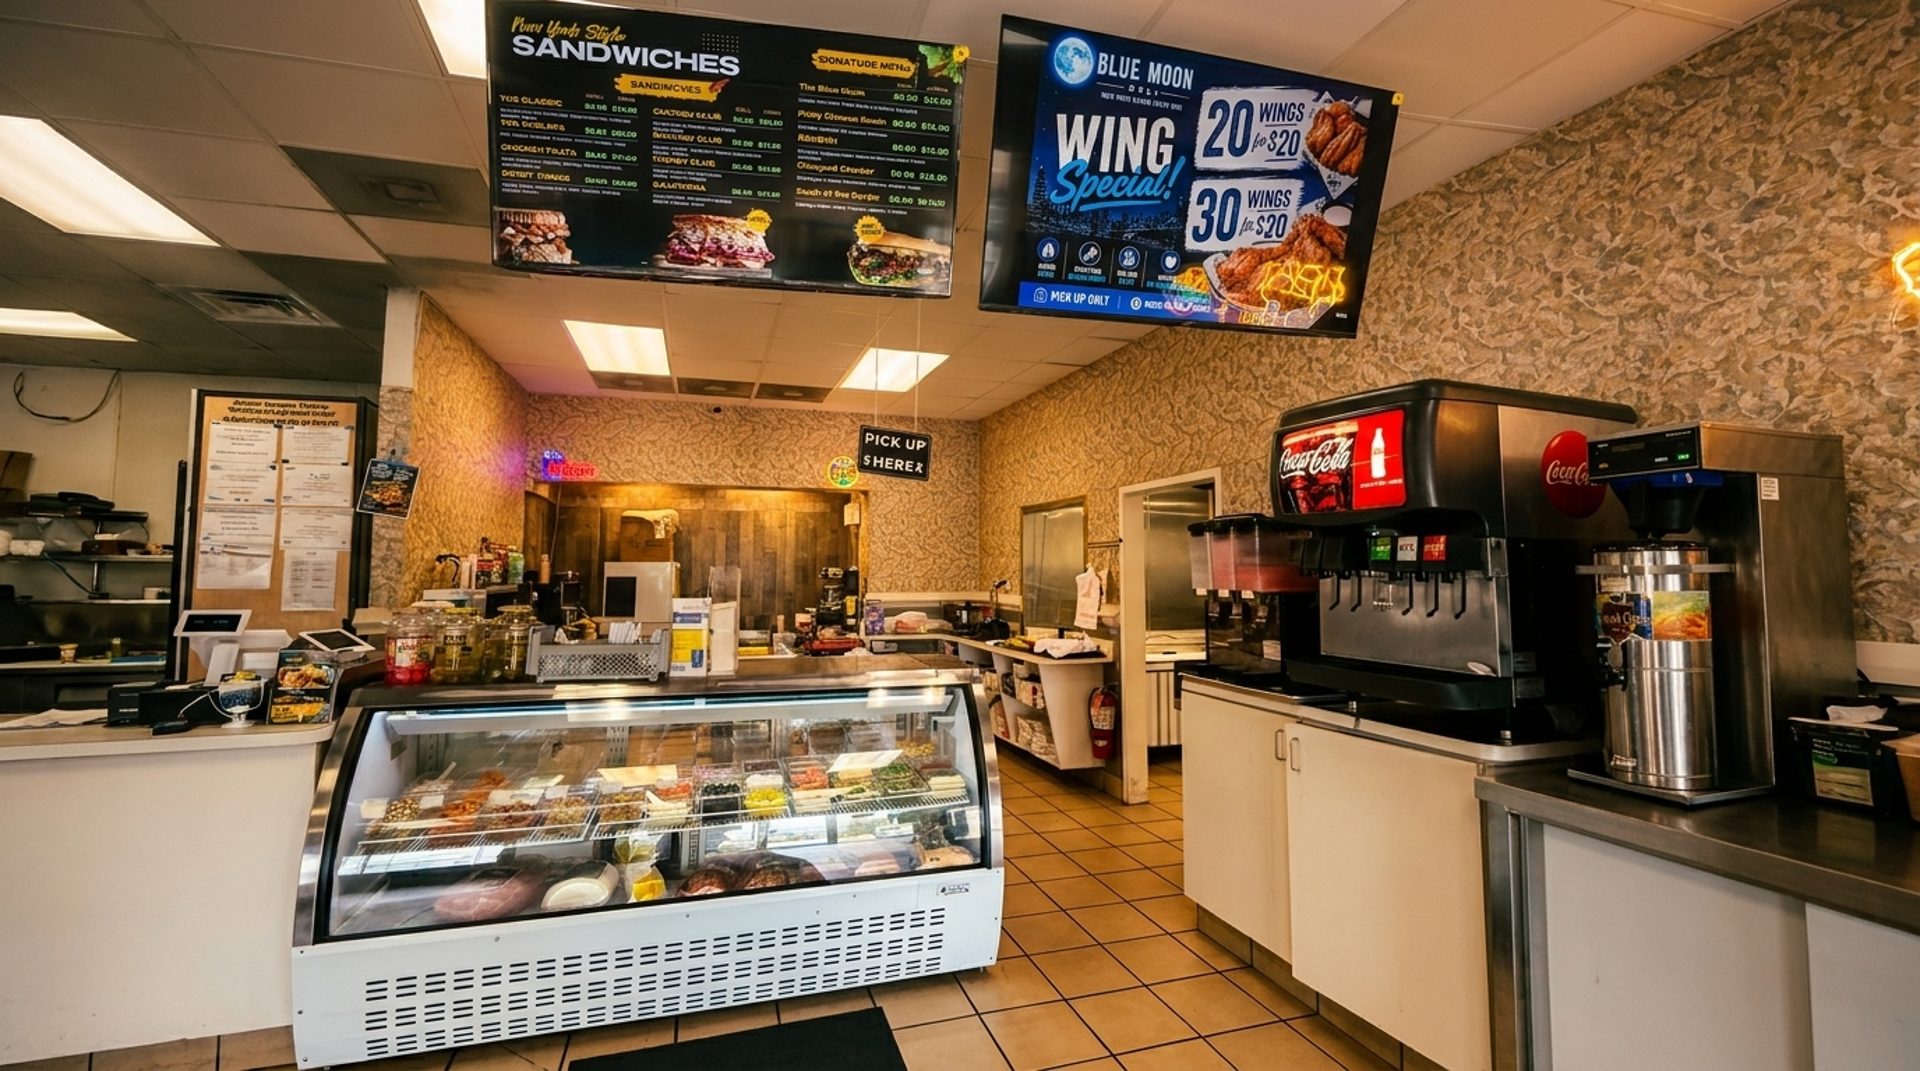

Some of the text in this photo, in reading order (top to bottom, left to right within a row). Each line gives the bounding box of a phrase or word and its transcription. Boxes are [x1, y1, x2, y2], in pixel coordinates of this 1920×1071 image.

[512, 34, 741, 77] SANDWICHES
[1097, 52, 1194, 90] BLUE MOON
[1056, 113, 1176, 175] WING
[1202, 99, 1254, 158] 20
[1259, 102, 1305, 123] WINGS
[1267, 130, 1301, 157] $20
[1050, 156, 1187, 213] Special!
[1192, 187, 1292, 242] 30 WINGS
[1256, 213, 1289, 239] $20
[1073, 293, 1086, 305] UP
[865, 432, 927, 451] PICK UP
